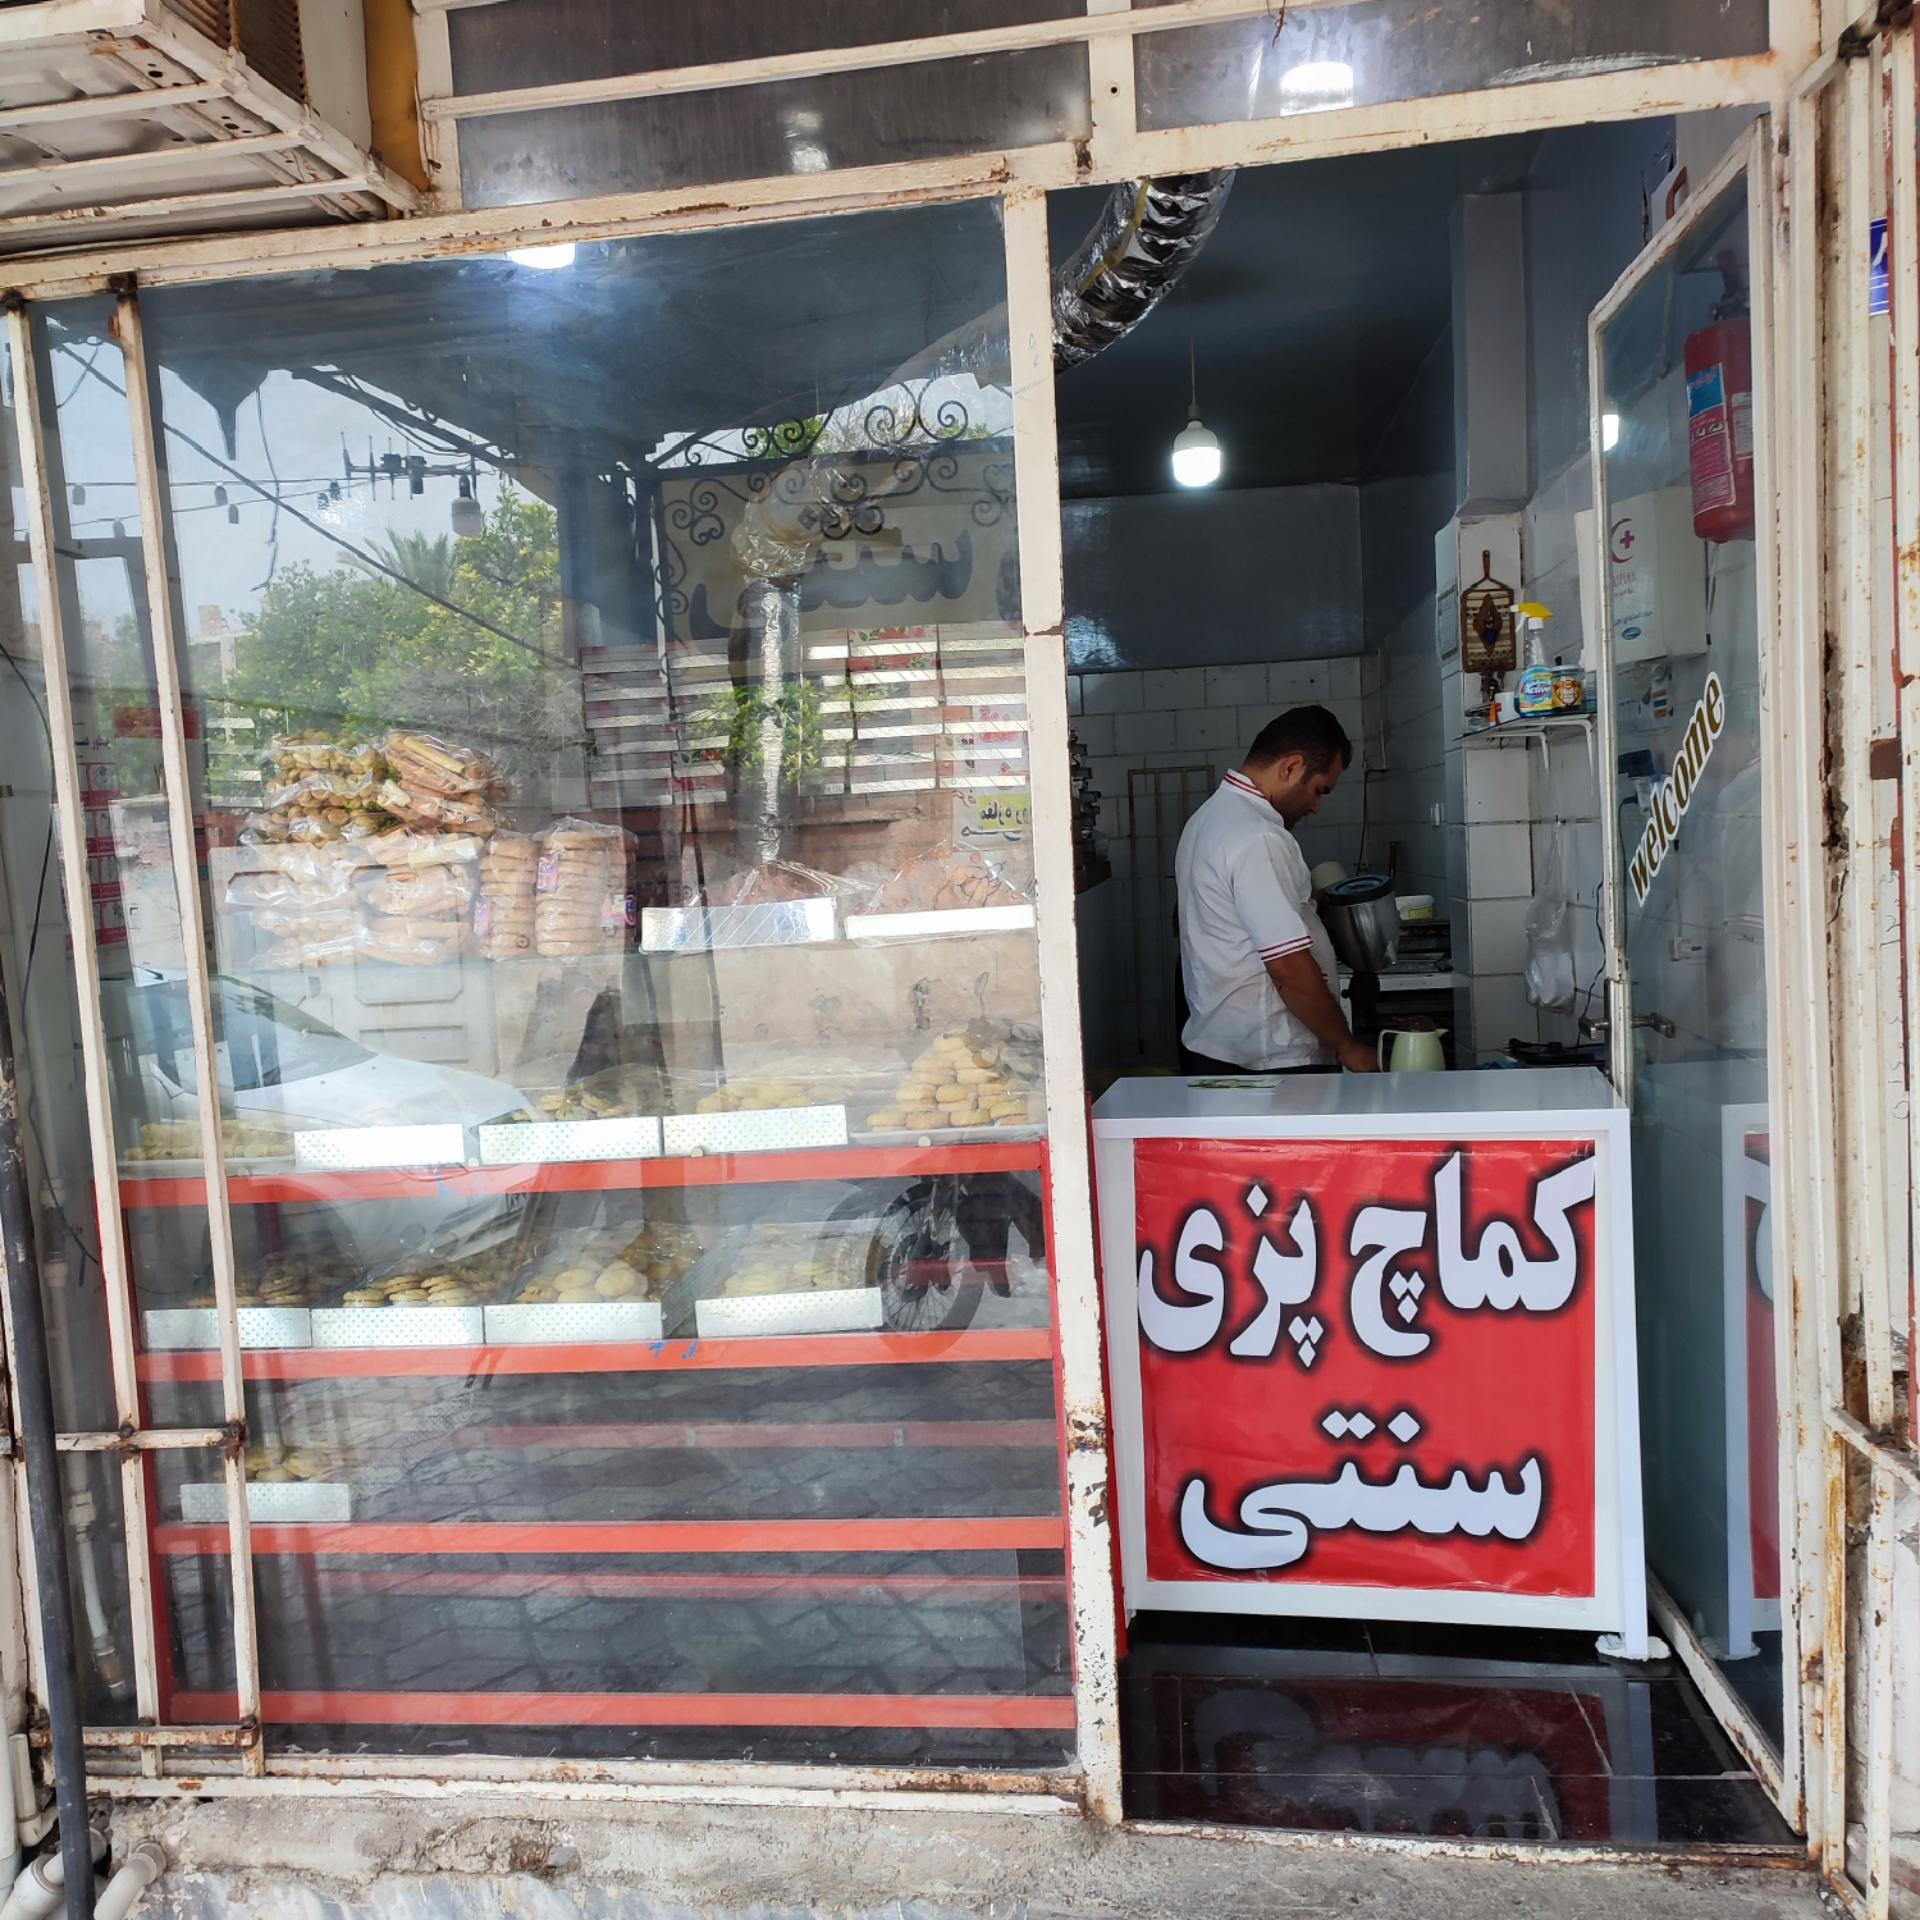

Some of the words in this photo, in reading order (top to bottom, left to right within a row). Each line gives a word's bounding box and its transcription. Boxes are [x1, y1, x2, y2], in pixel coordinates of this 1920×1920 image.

[1629, 672, 1724, 907] welcome
[1138, 1184, 1324, 1367] پزی
[1350, 1151, 1595, 1357] کماچ
[1180, 1410, 1543, 1569] سنتی
